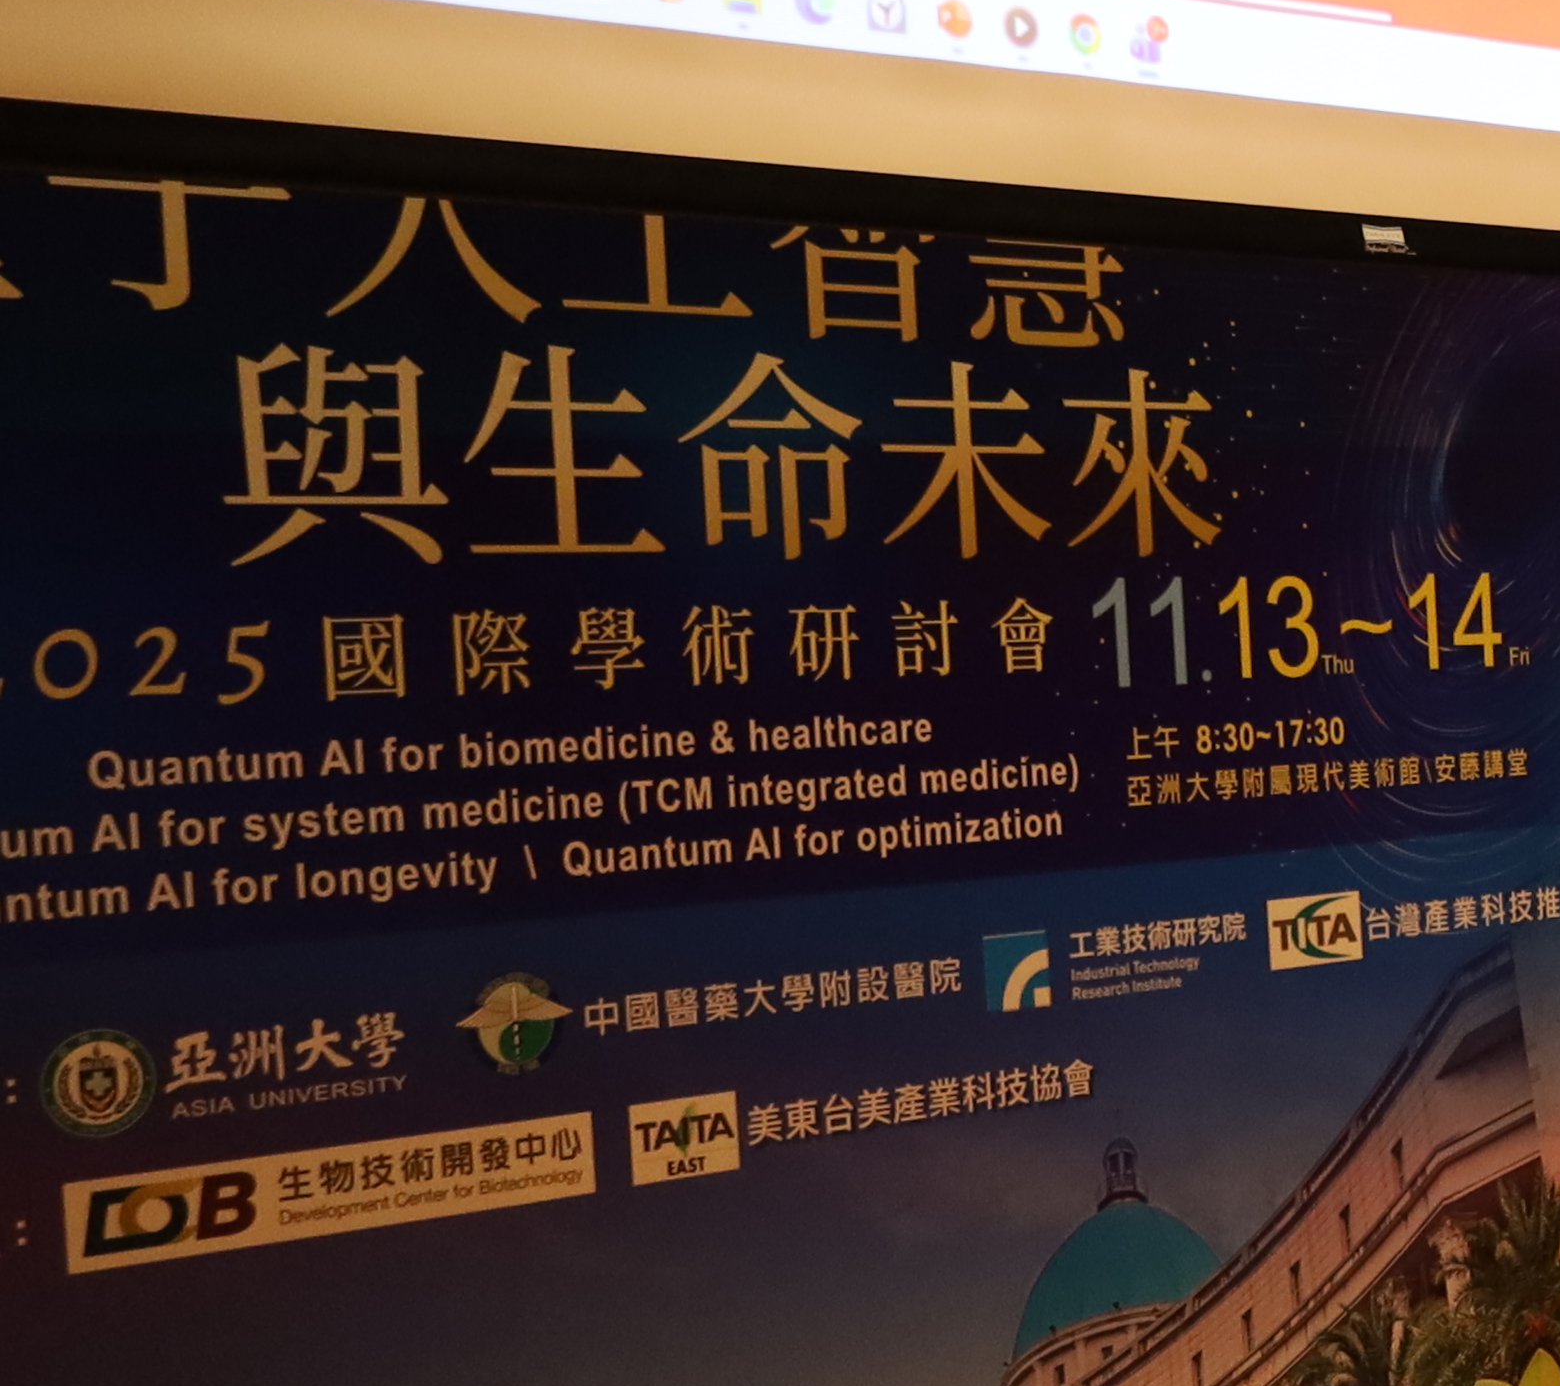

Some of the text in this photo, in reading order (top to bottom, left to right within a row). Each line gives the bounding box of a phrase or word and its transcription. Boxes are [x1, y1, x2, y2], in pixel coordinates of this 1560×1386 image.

[0, 175, 1124, 348] 子人工智慧
[222, 343, 1222, 567] 與生命未來
[0, 619, 270, 705] 025
[323, 596, 1053, 702] 國際學術研討會
[1321, 654, 1355, 675] Thu
[1509, 647, 1531, 666] Fri
[87, 715, 933, 790] Quantum AI for biomedicine & healthcare
[1127, 716, 1345, 761] 上午 8:30~17:30
[92, 813, 139, 852] AI
[158, 810, 225, 847] for
[243, 801, 405, 851] system
[423, 785, 604, 831] medicine
[618, 775, 713, 825] (TCM
[728, 764, 907, 812] integrated
[920, 753, 1079, 795] medicine)
[147, 872, 195, 911] AI
[212, 869, 278, 906] for
[297, 851, 498, 904] longevity
[562, 840, 733, 878] Quantum
[745, 827, 781, 862] AI
[793, 824, 844, 858] for
[857, 808, 1063, 859] optimization
[1069, 912, 1247, 959] 工業技術研究院
[1071, 956, 1200, 982] Industrial Technology
[584, 955, 962, 1036] 中國醫藥大學附設醫院
[1071, 975, 1183, 1001] Research Institute
[164, 1012, 405, 1093] 亞洲大學
[172, 1074, 408, 1120] ASIA UNIVERSITY
[747, 1057, 1094, 1147] 美東台美產業科技協會
[278, 1126, 582, 1203] 生物技術開發中心
[279, 1167, 583, 1226] Development Center for Biotechnology
[668, 1156, 706, 1177] EAST
